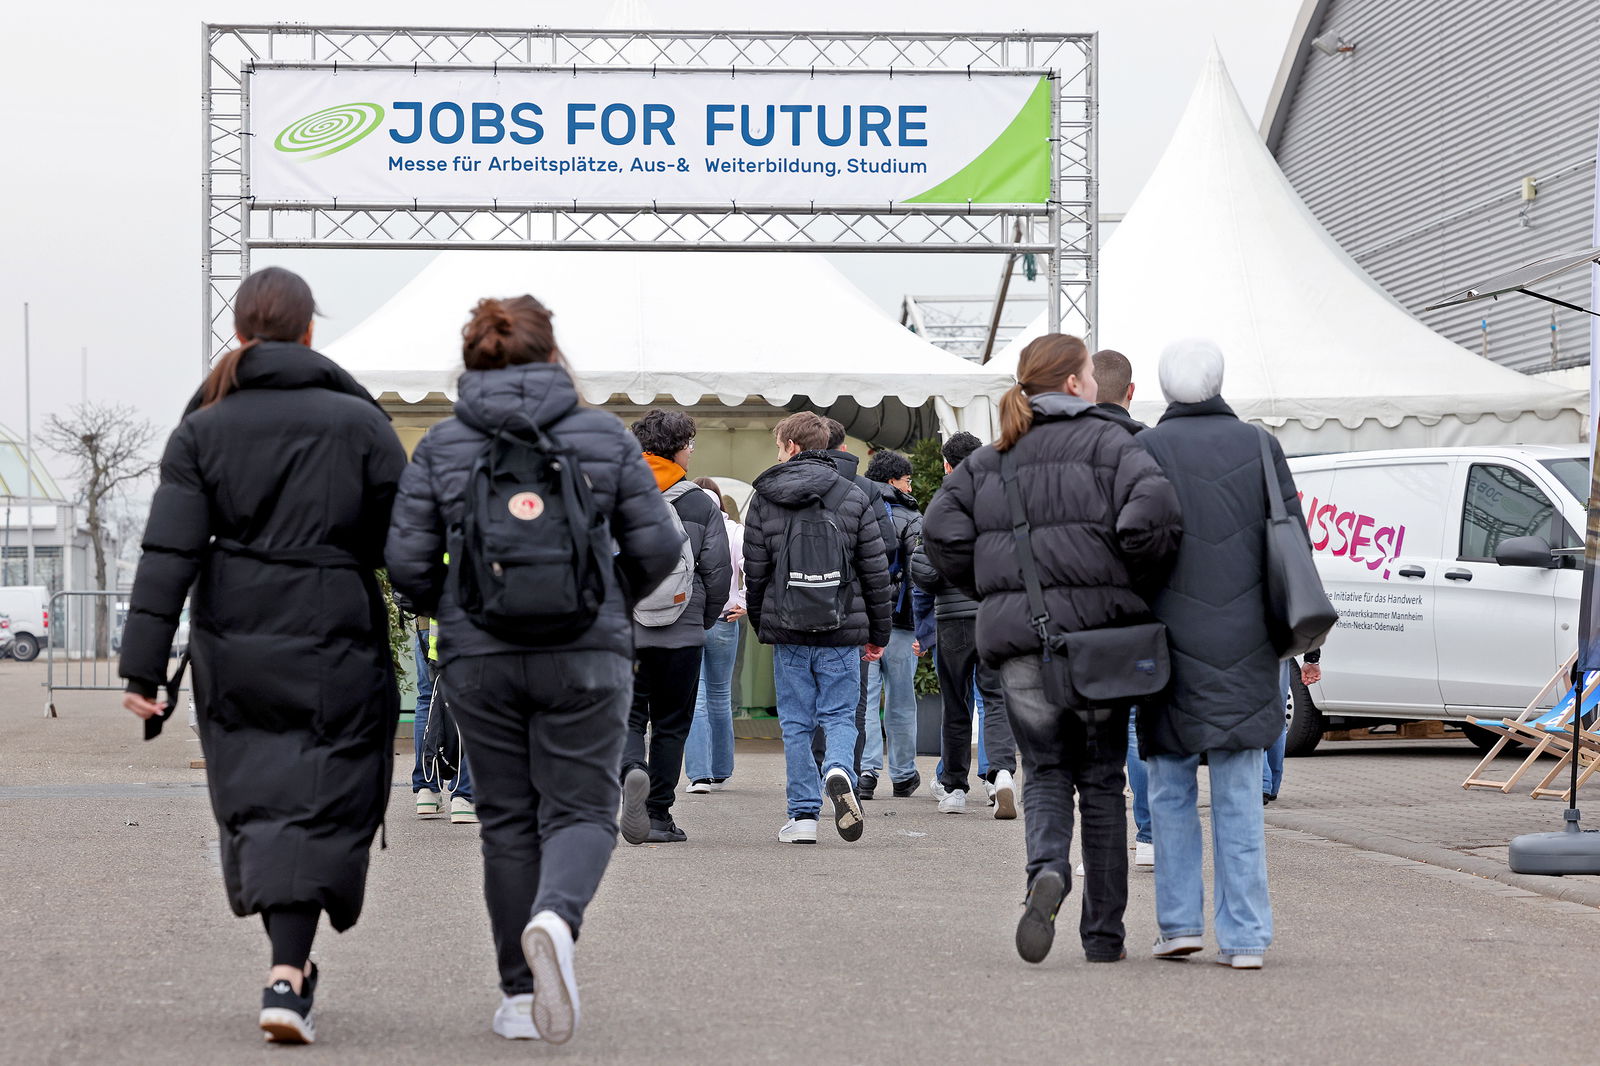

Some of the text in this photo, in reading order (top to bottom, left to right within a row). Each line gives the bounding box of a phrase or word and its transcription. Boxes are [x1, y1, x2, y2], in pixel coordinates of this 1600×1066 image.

[388, 101, 929, 147] JOBS FOR FUTURE
[388, 156, 448, 172] Messe
[453, 155, 482, 172] für
[488, 156, 623, 176] Arbeitsplätze,
[704, 157, 841, 177] Weiterbildung,
[847, 157, 927, 174] Studium
[1333, 591, 1362, 602] Initiative
[1363, 592, 1374, 603] für
[1374, 593, 1387, 603] das
[1387, 594, 1423, 605] Handwerk
[1336, 609, 1424, 621] Handwerkskammer Mannheim
[1335, 620, 1405, 632] Rhein-Neckar-Odenwald
